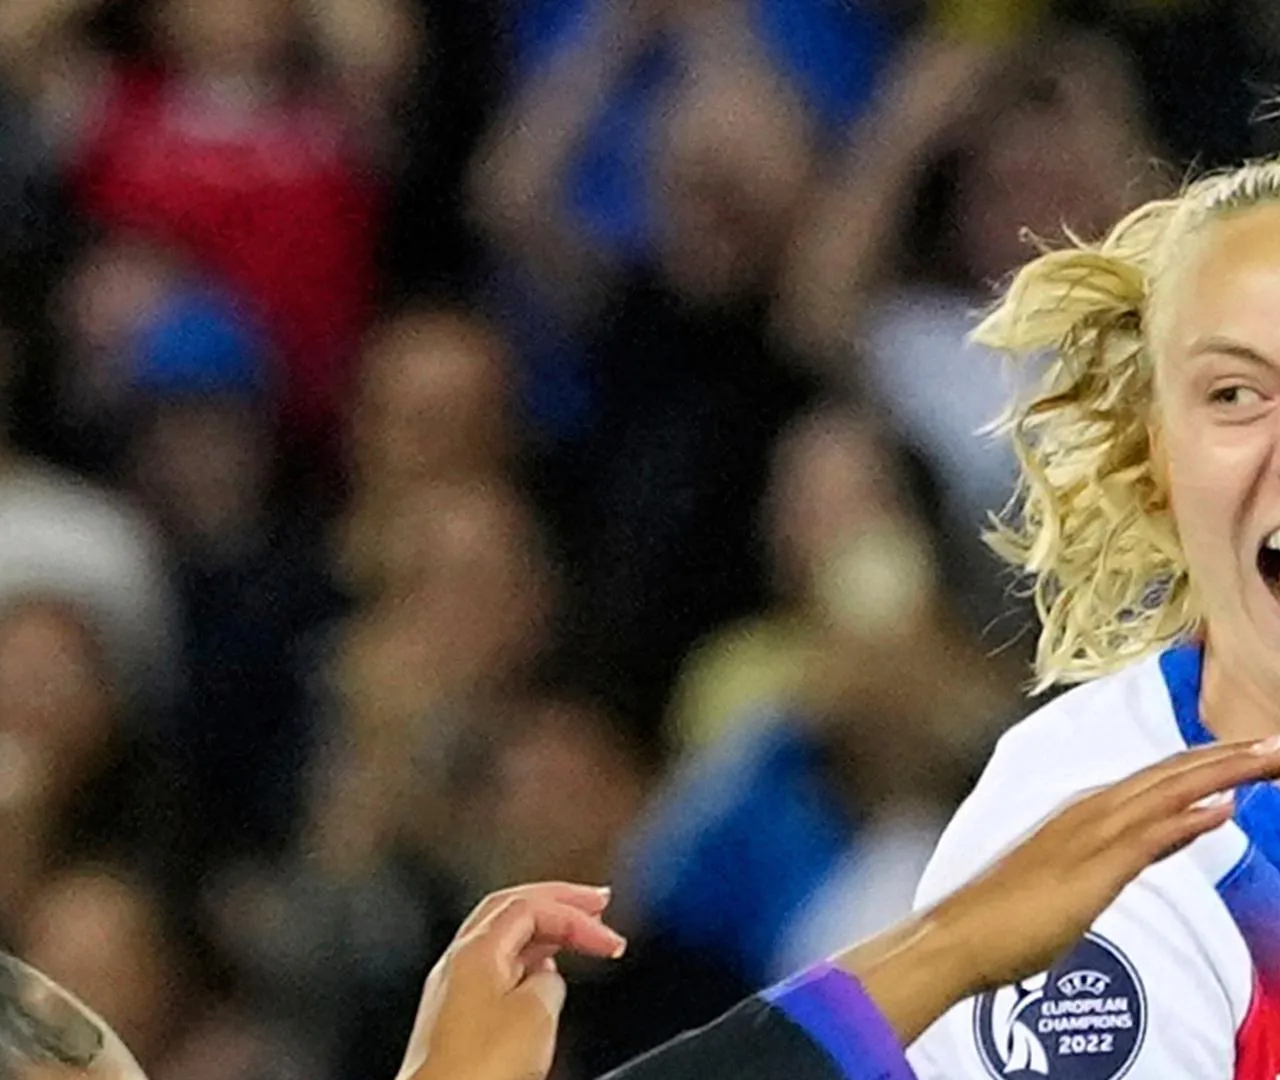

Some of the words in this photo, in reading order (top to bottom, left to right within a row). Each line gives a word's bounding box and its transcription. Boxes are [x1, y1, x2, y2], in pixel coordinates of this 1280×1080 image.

[1057, 969, 1111, 997] UEFA
[1041, 997, 1128, 1016] EUROPEAN
[1038, 1012, 1133, 1033] CHAMPIONS
[1058, 1033, 1114, 1054] 2022
